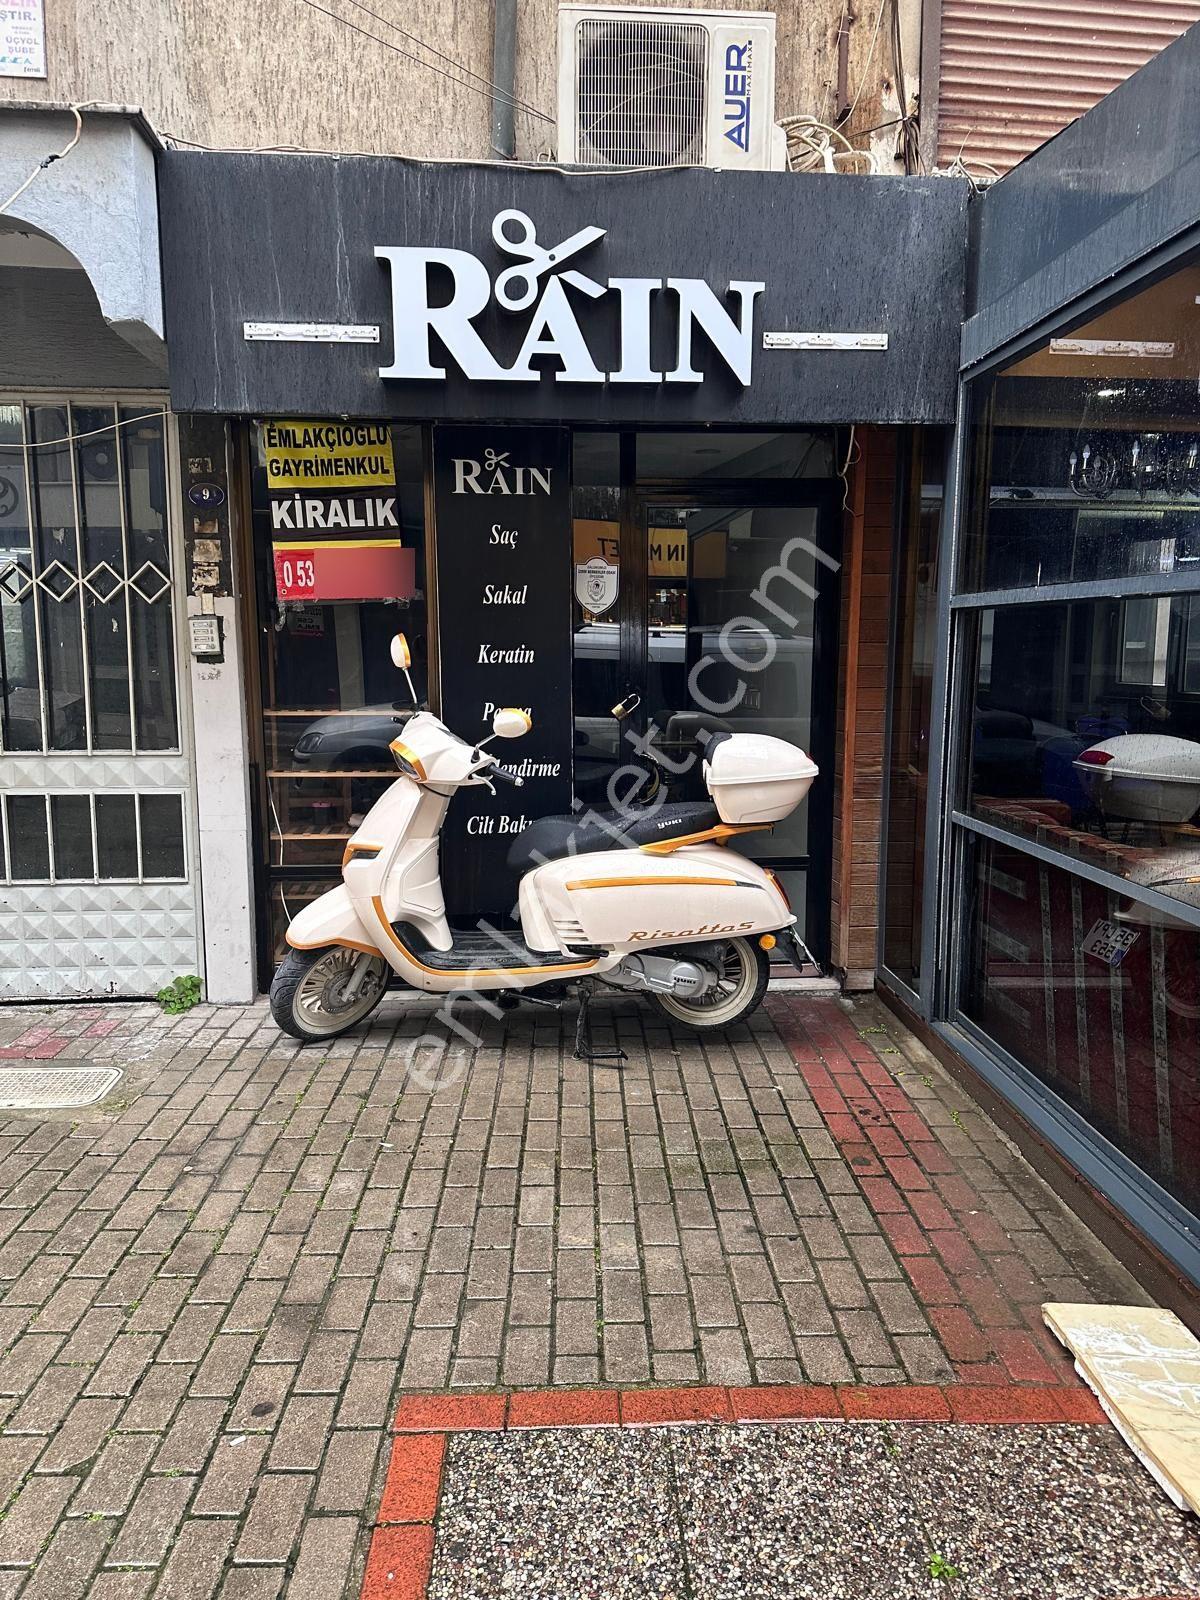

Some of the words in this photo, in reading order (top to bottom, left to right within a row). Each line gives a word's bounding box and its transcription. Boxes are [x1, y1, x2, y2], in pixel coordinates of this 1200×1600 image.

[723, 44, 748, 150] AUER
[374, 246, 766, 386] RAIN
[269, 454, 390, 477] GAYRİMENKUL
[451, 459, 553, 496] RAIN
[202, 488, 210, 500] 9
[271, 493, 399, 529] KİRALIK
[489, 524, 519, 549] Saç
[283, 560, 293, 588] 0
[482, 583, 528, 605] Sakal
[477, 643, 535, 665] Keratin
[466, 815, 495, 835] Cilt
